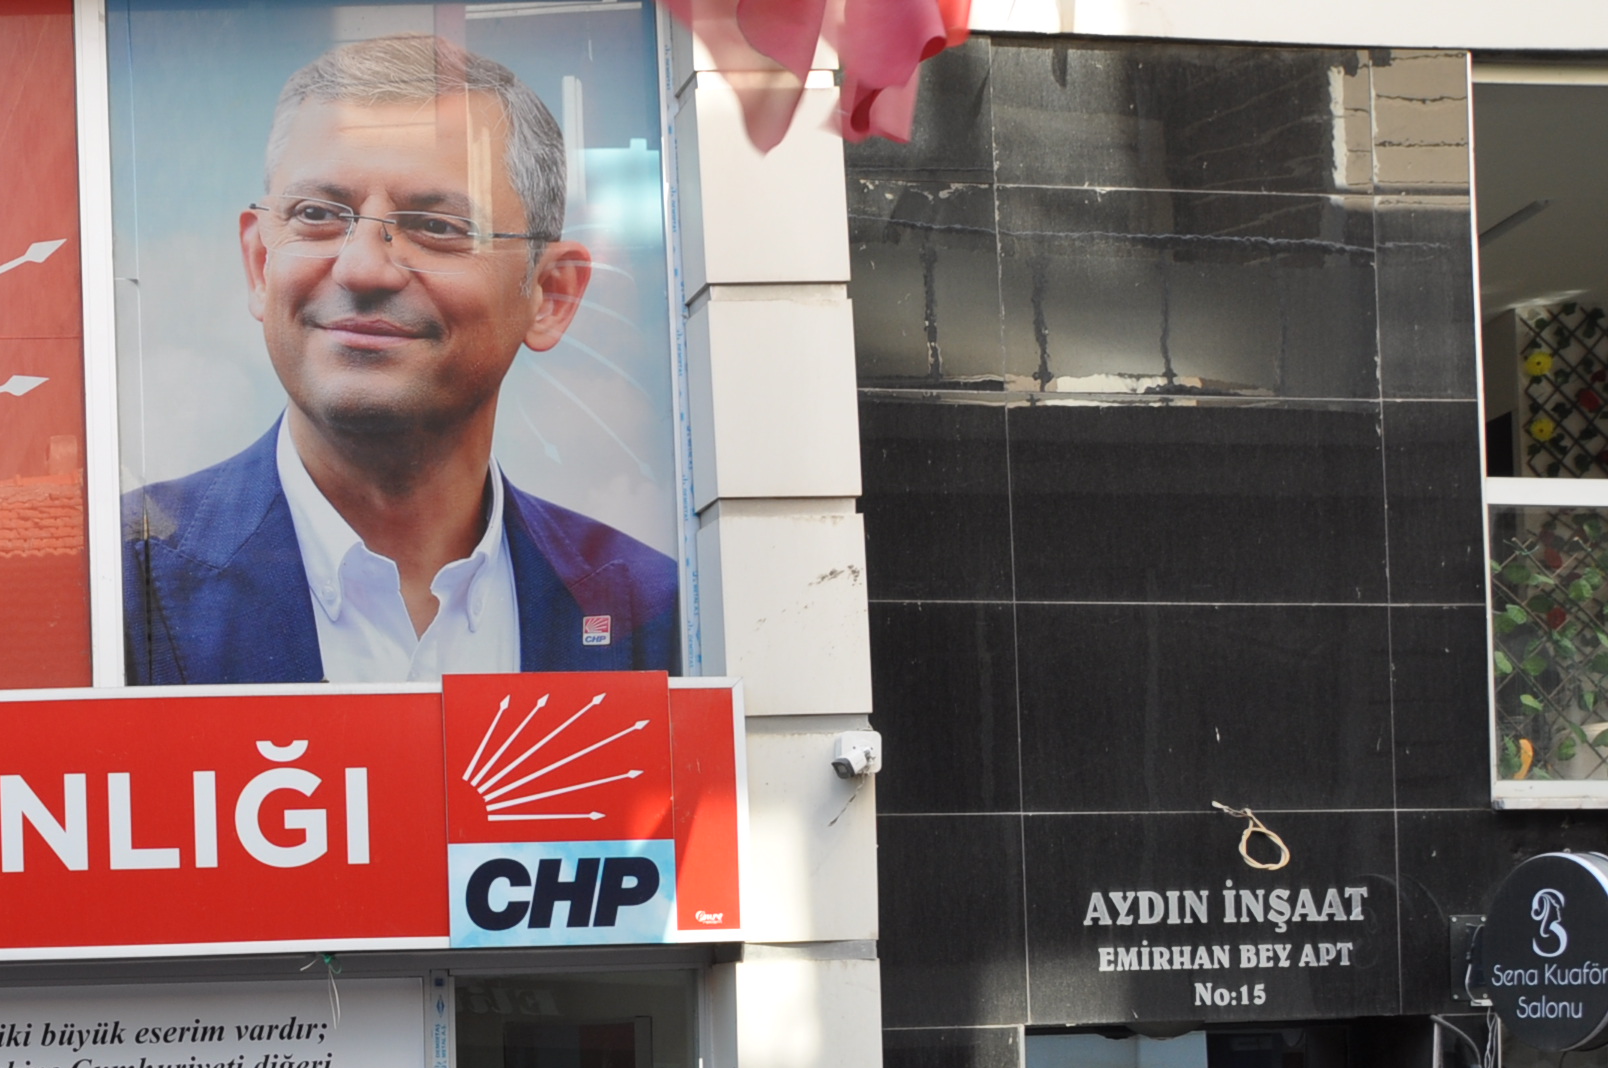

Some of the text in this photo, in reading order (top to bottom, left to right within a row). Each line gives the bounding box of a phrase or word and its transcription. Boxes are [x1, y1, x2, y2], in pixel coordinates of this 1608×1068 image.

[466, 856, 660, 932] CHP
[1083, 879, 1368, 933] AYDIN İNŞAAT
[1098, 940, 1353, 972] EMİRHAN BEY APT
[1492, 961, 1608, 986] Sena Kuaför
[1193, 983, 1266, 1006] No:15
[1516, 995, 1582, 1018] Salonu
[41, 1021, 126, 1052] büyük
[135, 1018, 225, 1044] eserim
[235, 1016, 328, 1044] vardır;
